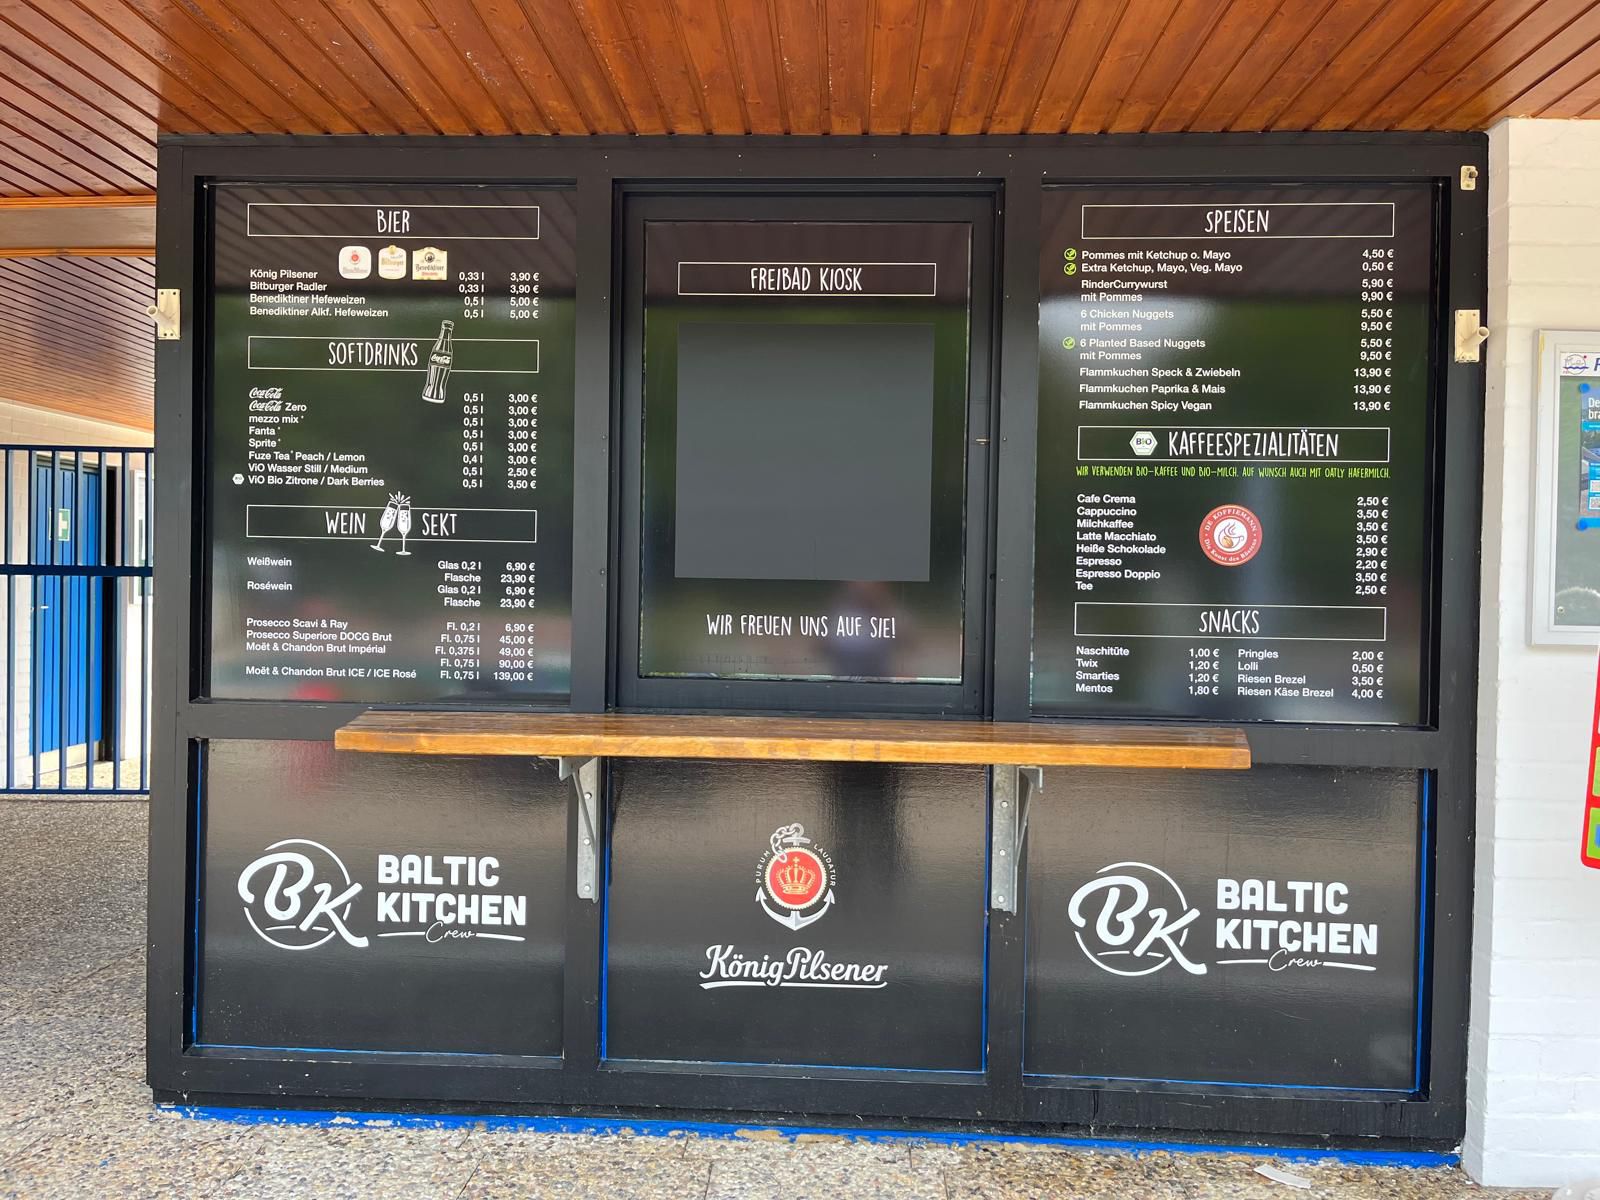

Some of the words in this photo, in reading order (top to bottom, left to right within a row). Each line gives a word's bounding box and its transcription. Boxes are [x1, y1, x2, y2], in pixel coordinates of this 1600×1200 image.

[377, 210, 410, 233] BIER
[1205, 209, 1269, 234] SPEISEN
[1082, 251, 1125, 259] Pommes
[1128, 251, 1143, 259] mit
[1146, 250, 1188, 261] Ketchup
[1203, 250, 1231, 261] Mayo
[1362, 249, 1384, 259] 4,50
[1082, 263, 1107, 272] Extra
[1110, 263, 1154, 273] Ketchup,
[1157, 263, 1187, 273] Mayo,
[1190, 263, 1211, 273] Veg.
[1215, 263, 1243, 273] Mayo
[250, 269, 277, 280] König
[280, 270, 318, 278] Pilsener
[459, 272, 479, 281] 0,33
[511, 272, 530, 282] 3,90
[751, 267, 810, 290] FREIBAD
[820, 268, 862, 291] KIOSK
[250, 281, 294, 292] Bitburger
[296, 282, 327, 291] Radler
[1082, 280, 1167, 290] RinderCurrywurst
[250, 294, 309, 303] Benediktiner
[311, 295, 365, 304] Hefeweizen
[1081, 292, 1096, 301] mit
[1100, 292, 1142, 301] Pommes
[250, 306, 309, 316] Benediktiner
[311, 308, 331, 316] Alkf.
[335, 308, 388, 317] Hefeweizen
[1090, 309, 1129, 318] Chicken
[1133, 309, 1174, 320] Nuggets
[1089, 339, 1126, 347] Planted
[1130, 339, 1160, 347] Based
[1164, 338, 1206, 349] Nuggets
[329, 342, 418, 366] SOFTDRINKS
[1080, 368, 1149, 376] Flammkuchen
[1152, 368, 1183, 378] Speck
[1195, 368, 1240, 376] Zwiebeln
[464, 393, 478, 403] 0,5
[509, 394, 529, 403] 3,00
[285, 403, 307, 411] Zero
[1169, 429, 1338, 457] KAFFEESPEZIALITÄTEN
[249, 451, 271, 460] Fuze
[295, 452, 324, 461] Peach
[333, 453, 365, 461] Lemon
[248, 463, 265, 472] ViO
[267, 463, 302, 472] Wasser
[304, 464, 321, 473] Still
[331, 465, 367, 473] Medium
[1076, 466, 1088, 475] WIR
[1092, 466, 1133, 476] VERWENDEN
[1136, 466, 1178, 476] BIO-KAFFEE
[1182, 466, 1195, 477] UND
[1199, 467, 1238, 477] BIO-MILCH.
[1242, 467, 1254, 477] AUF
[1259, 467, 1286, 477] WUNSCH
[1290, 467, 1306, 477] AUCH
[1310, 468, 1321, 478] MIT
[1325, 468, 1345, 478] OATLY
[1349, 468, 1390, 478] HAFERMILCH.
[1077, 494, 1100, 503] Cafe
[1103, 494, 1135, 503] Crema
[1357, 497, 1379, 507] 2,50
[1077, 506, 1137, 517] Cappuccino
[326, 512, 365, 534] WEIN
[422, 513, 457, 536] SEKT
[1077, 519, 1133, 528] Milchkaffee
[1077, 532, 1102, 540] Latte
[1105, 532, 1156, 541] Macchiato
[1077, 544, 1105, 553] Heiße
[1107, 544, 1166, 554] Schokolade
[247, 557, 292, 566] Weißwein
[506, 562, 526, 571] 6,90
[1076, 556, 1122, 567] Espresso
[445, 573, 481, 582] Flasche
[1076, 569, 1122, 580] Espresso
[1125, 569, 1160, 580] Doppio
[247, 581, 292, 590] Roséwein
[1075, 581, 1093, 590] Tee
[444, 597, 480, 607] Flasche
[247, 618, 290, 627] Prosecco
[293, 619, 318, 627] Scavi
[330, 620, 348, 630] Ray
[707, 614, 732, 635] WIR
[741, 615, 791, 636] FREUEN
[800, 615, 828, 637] UNS
[837, 616, 861, 637] AUF
[871, 617, 895, 638] SIE!
[1199, 610, 1259, 634] SNACKS
[247, 642, 270, 651] Moët
[282, 642, 324, 652] Chandon
[327, 644, 346, 652] Brut
[349, 644, 386, 655] Impérial
[1189, 648, 1210, 658] 1,00
[1238, 649, 1278, 660] Pringles
[1353, 651, 1374, 661] 2,00
[1076, 658, 1098, 667] Twix
[1238, 662, 1258, 670] Lolli
[1076, 671, 1119, 680] Smarties
[1238, 674, 1271, 683] Riesen
[1275, 675, 1305, 684] Brezel
[1076, 683, 1113, 693] Mentos
[1238, 687, 1271, 696] Riesen
[1274, 687, 1299, 696] Käse
[1302, 688, 1333, 697] Brezel
[755, 850, 770, 883] PURUM
[813, 843, 836, 886] LAUDATUR
[378, 854, 499, 886] BALTIC
[1217, 878, 1348, 914] BALTIC
[377, 891, 526, 926] KITCHEN
[425, 921, 475, 943] Crew
[1216, 918, 1377, 955] KITCHEN
[1268, 949, 1322, 972] Crew
